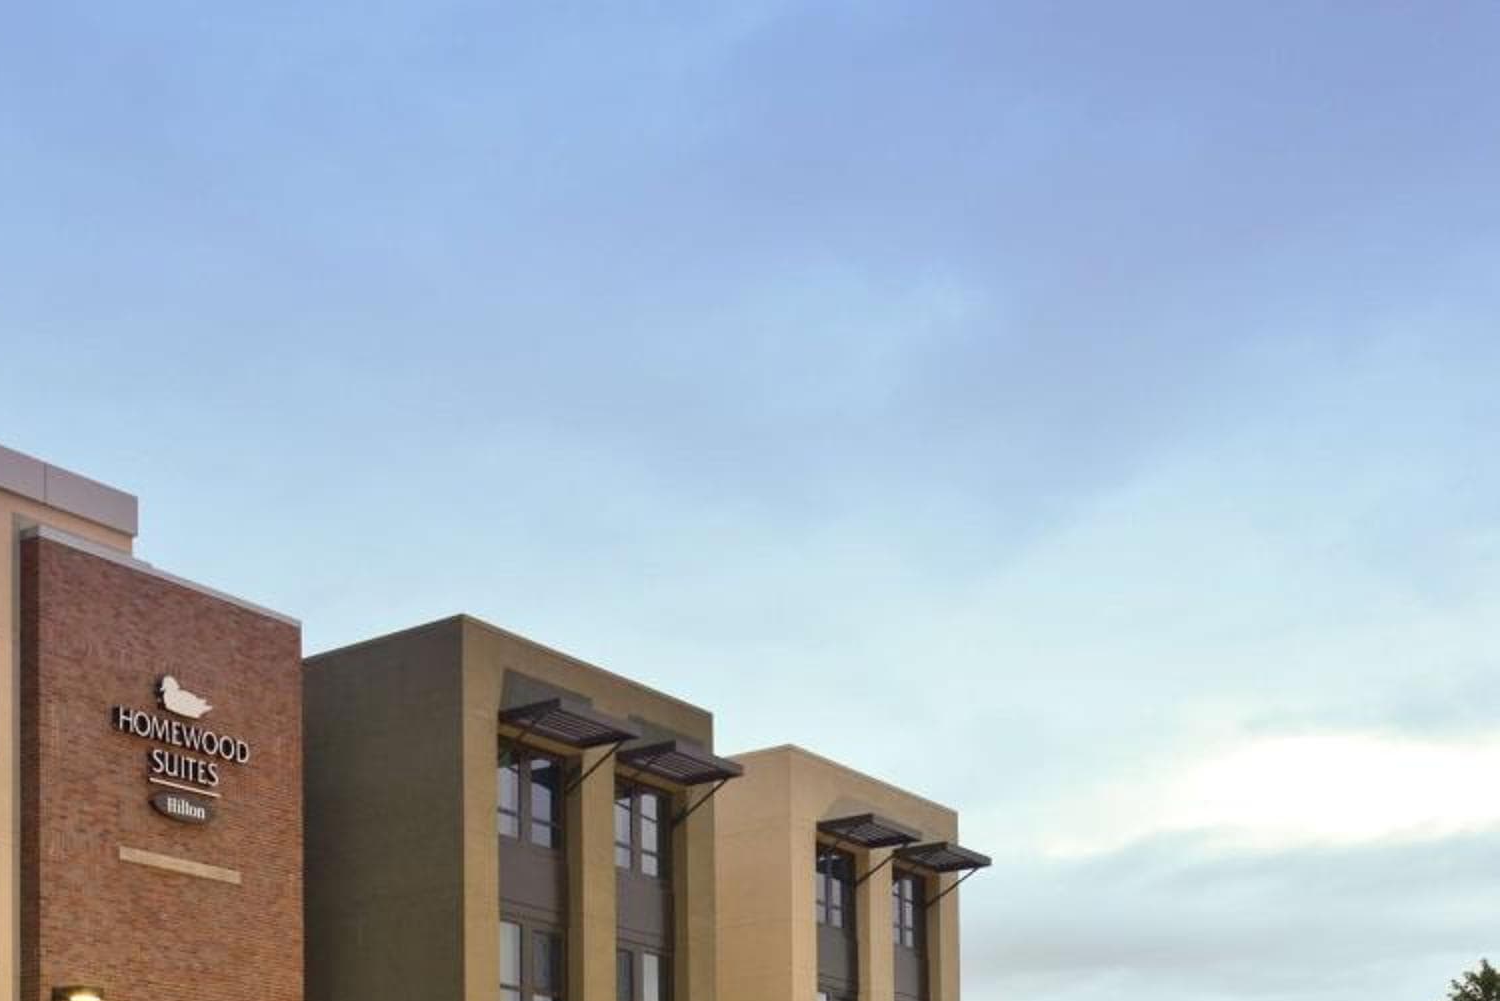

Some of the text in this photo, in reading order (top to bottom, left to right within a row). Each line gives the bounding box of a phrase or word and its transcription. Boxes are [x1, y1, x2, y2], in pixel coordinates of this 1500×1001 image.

[119, 704, 250, 764] HOMEWOOD
[152, 749, 219, 786] SUITES
[167, 797, 206, 819] Hilton
